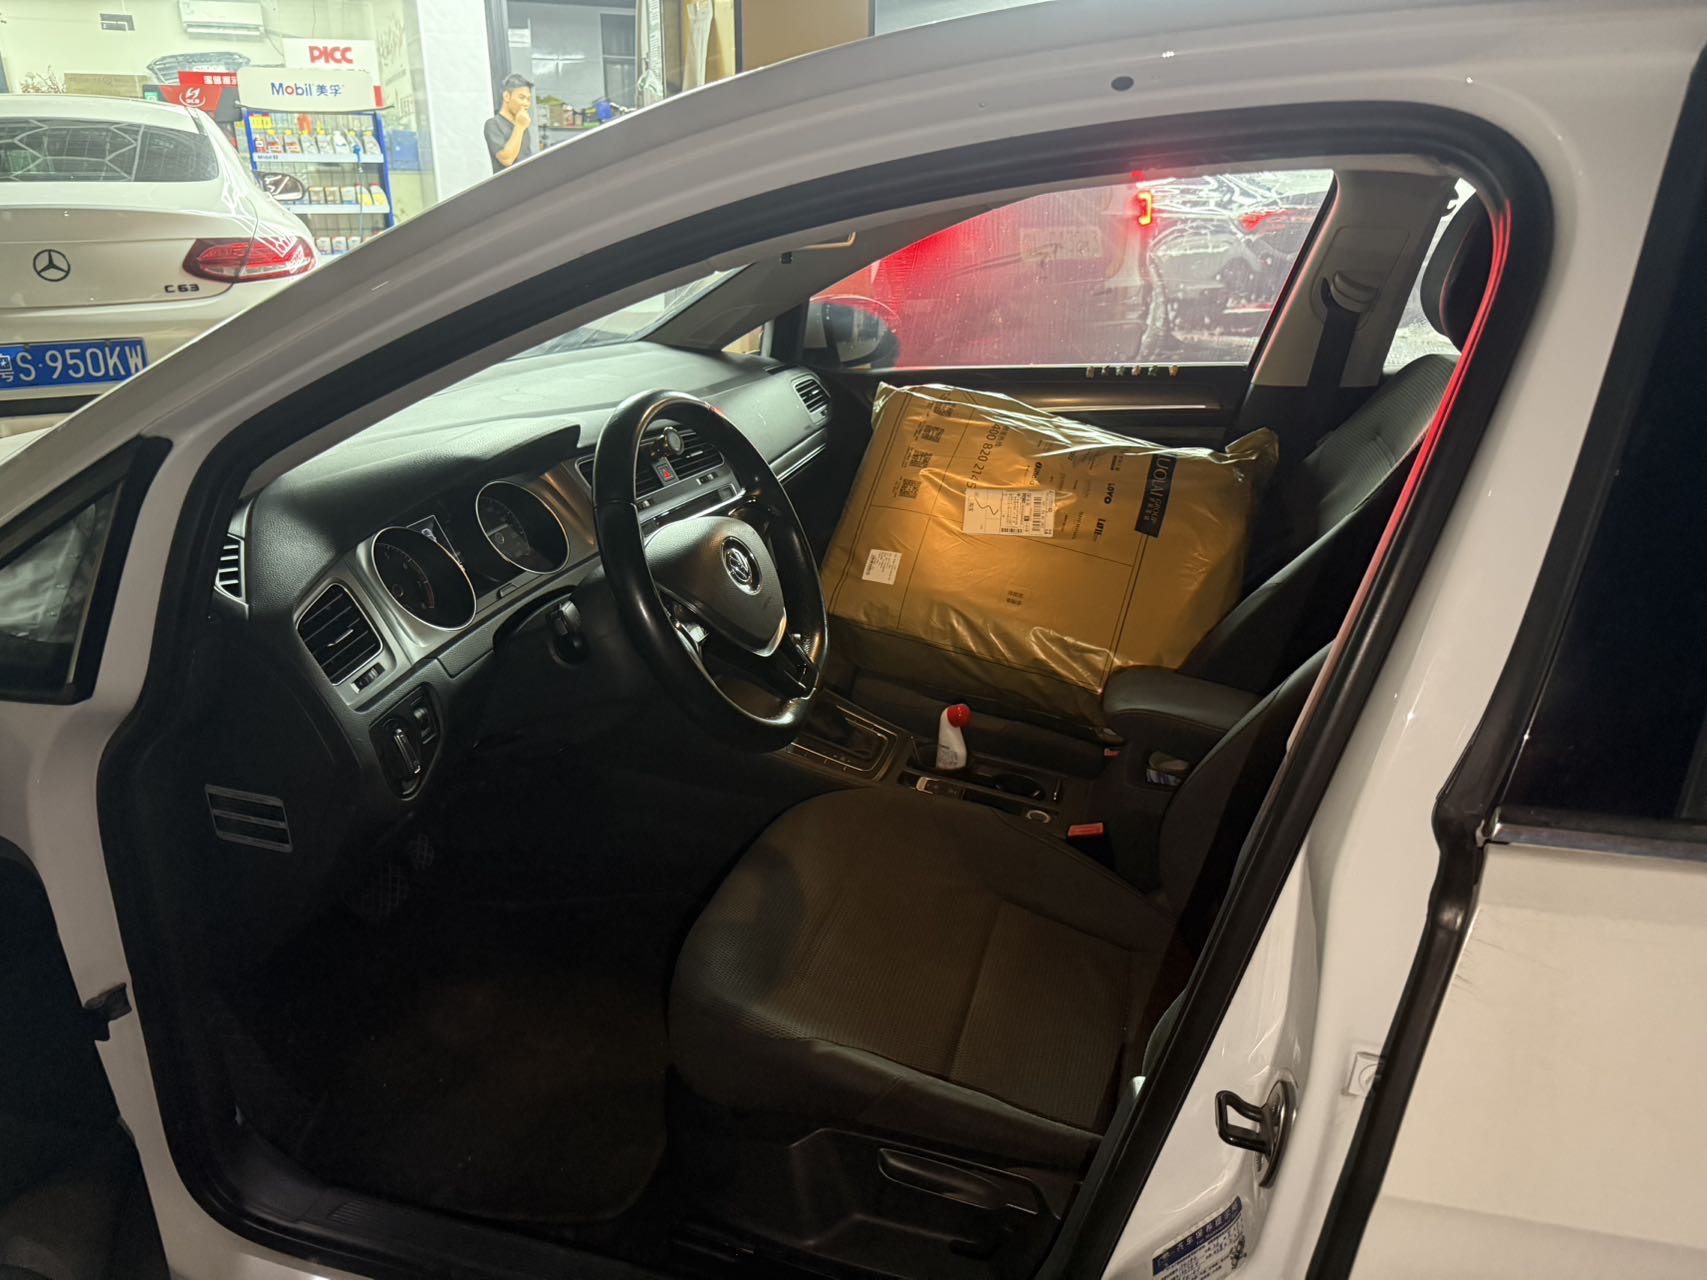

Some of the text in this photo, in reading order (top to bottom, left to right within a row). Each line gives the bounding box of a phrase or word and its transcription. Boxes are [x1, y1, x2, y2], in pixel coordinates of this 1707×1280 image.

[308, 45, 354, 64] PICC
[271, 82, 342, 97] Mobil 美孚
[977, 443, 993, 462] 820
